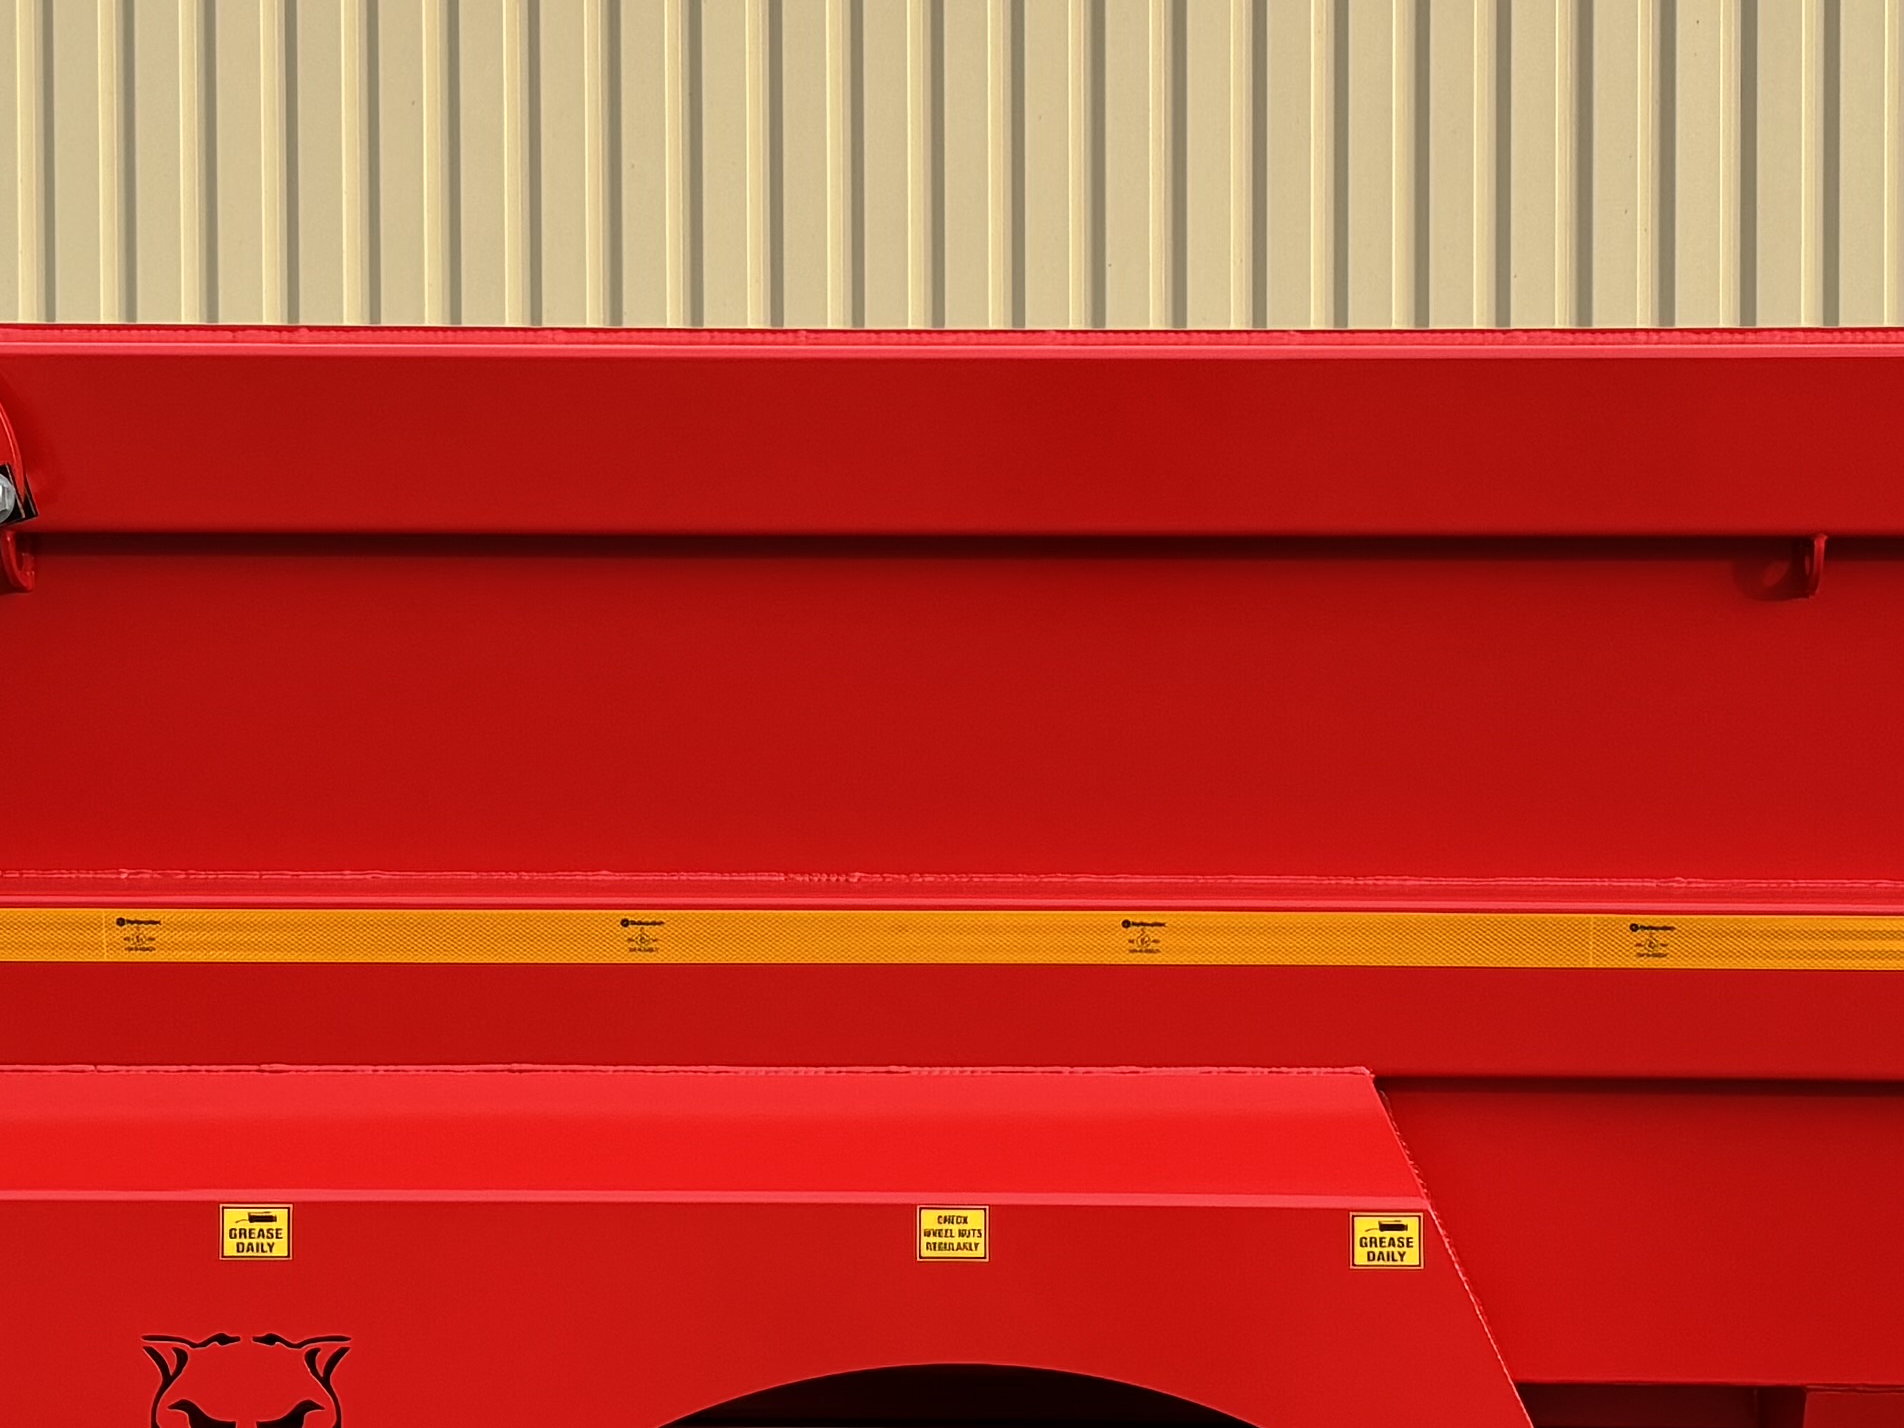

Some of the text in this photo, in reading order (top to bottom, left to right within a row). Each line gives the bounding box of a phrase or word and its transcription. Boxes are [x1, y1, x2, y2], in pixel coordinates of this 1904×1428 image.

[228, 1227, 284, 1240] GREASE
[236, 1241, 276, 1253] DAILY
[1359, 1236, 1414, 1248] GREASE
[1366, 1250, 1407, 1262] DAILY
